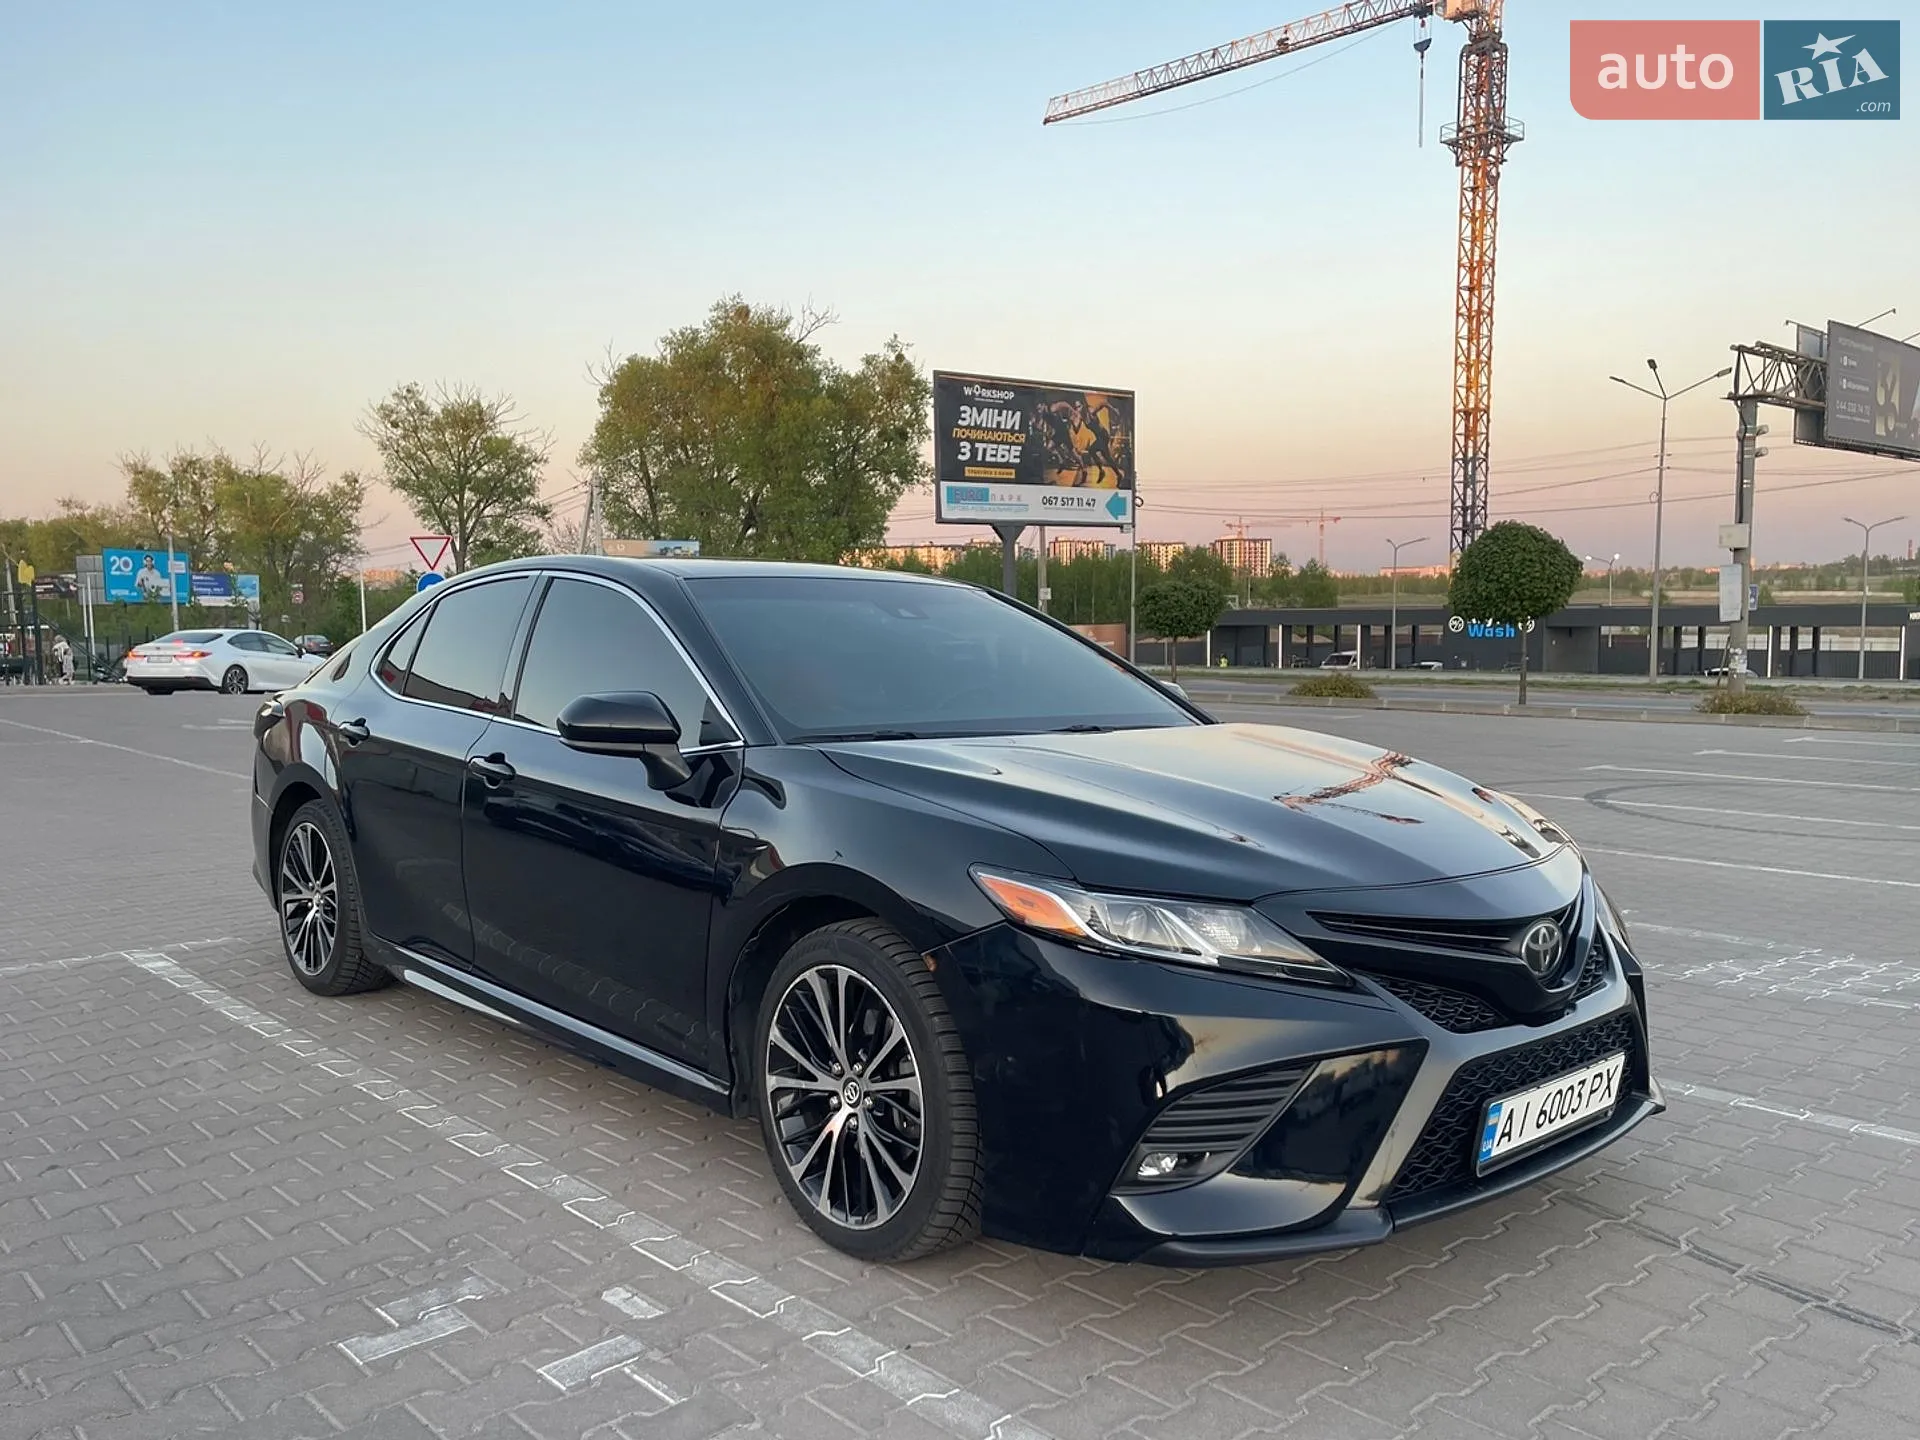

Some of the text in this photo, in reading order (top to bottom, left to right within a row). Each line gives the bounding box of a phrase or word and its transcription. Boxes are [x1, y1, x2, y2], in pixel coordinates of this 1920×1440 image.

[963, 384, 1015, 400] WORKSHOP
[958, 405, 1021, 430] ЗМІНИ
[952, 427, 1026, 443] ПОЧИНАЮТЬСЯ
[957, 441, 1022, 464] З ТЕБЕ
[1042, 495, 1097, 508] 067 517 11 47
[109, 555, 133, 571] 20
[1467, 624, 1516, 638] Wash
[1496, 1064, 1620, 1147] AI 6003 PX
